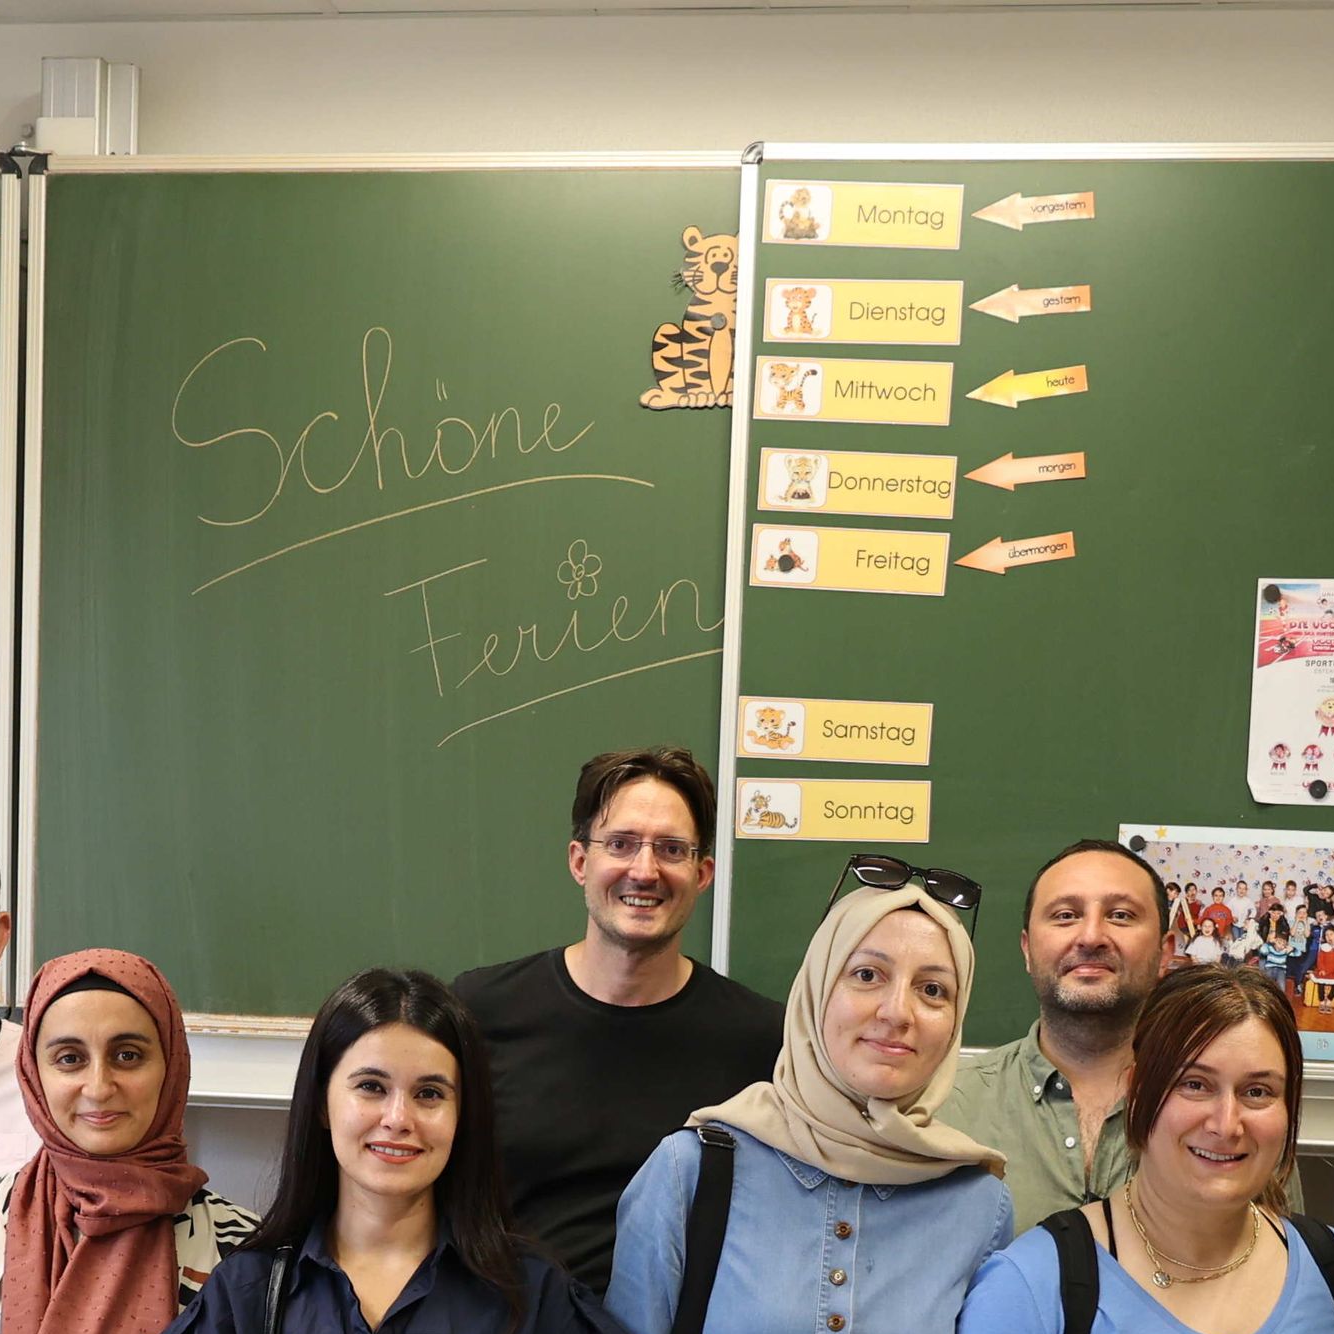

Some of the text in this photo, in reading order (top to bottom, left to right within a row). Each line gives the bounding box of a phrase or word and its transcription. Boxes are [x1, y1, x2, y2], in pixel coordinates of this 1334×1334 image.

[856, 204, 945, 231] Montag
[1030, 199, 1087, 213] vorgestern
[849, 300, 946, 327] Dienstag
[1042, 294, 1082, 308] gestern
[833, 379, 937, 402] Mittwoch
[1045, 374, 1076, 388] heute
[172, 327, 595, 526] Schöne
[1038, 461, 1076, 474] morgen
[828, 471, 952, 499] Donnerstag
[855, 549, 931, 576] Freitag
[1008, 541, 1068, 560] übermorgen
[383, 557, 725, 697] Ferien
[822, 719, 916, 746] Samstag
[823, 800, 915, 825] Sonntag
